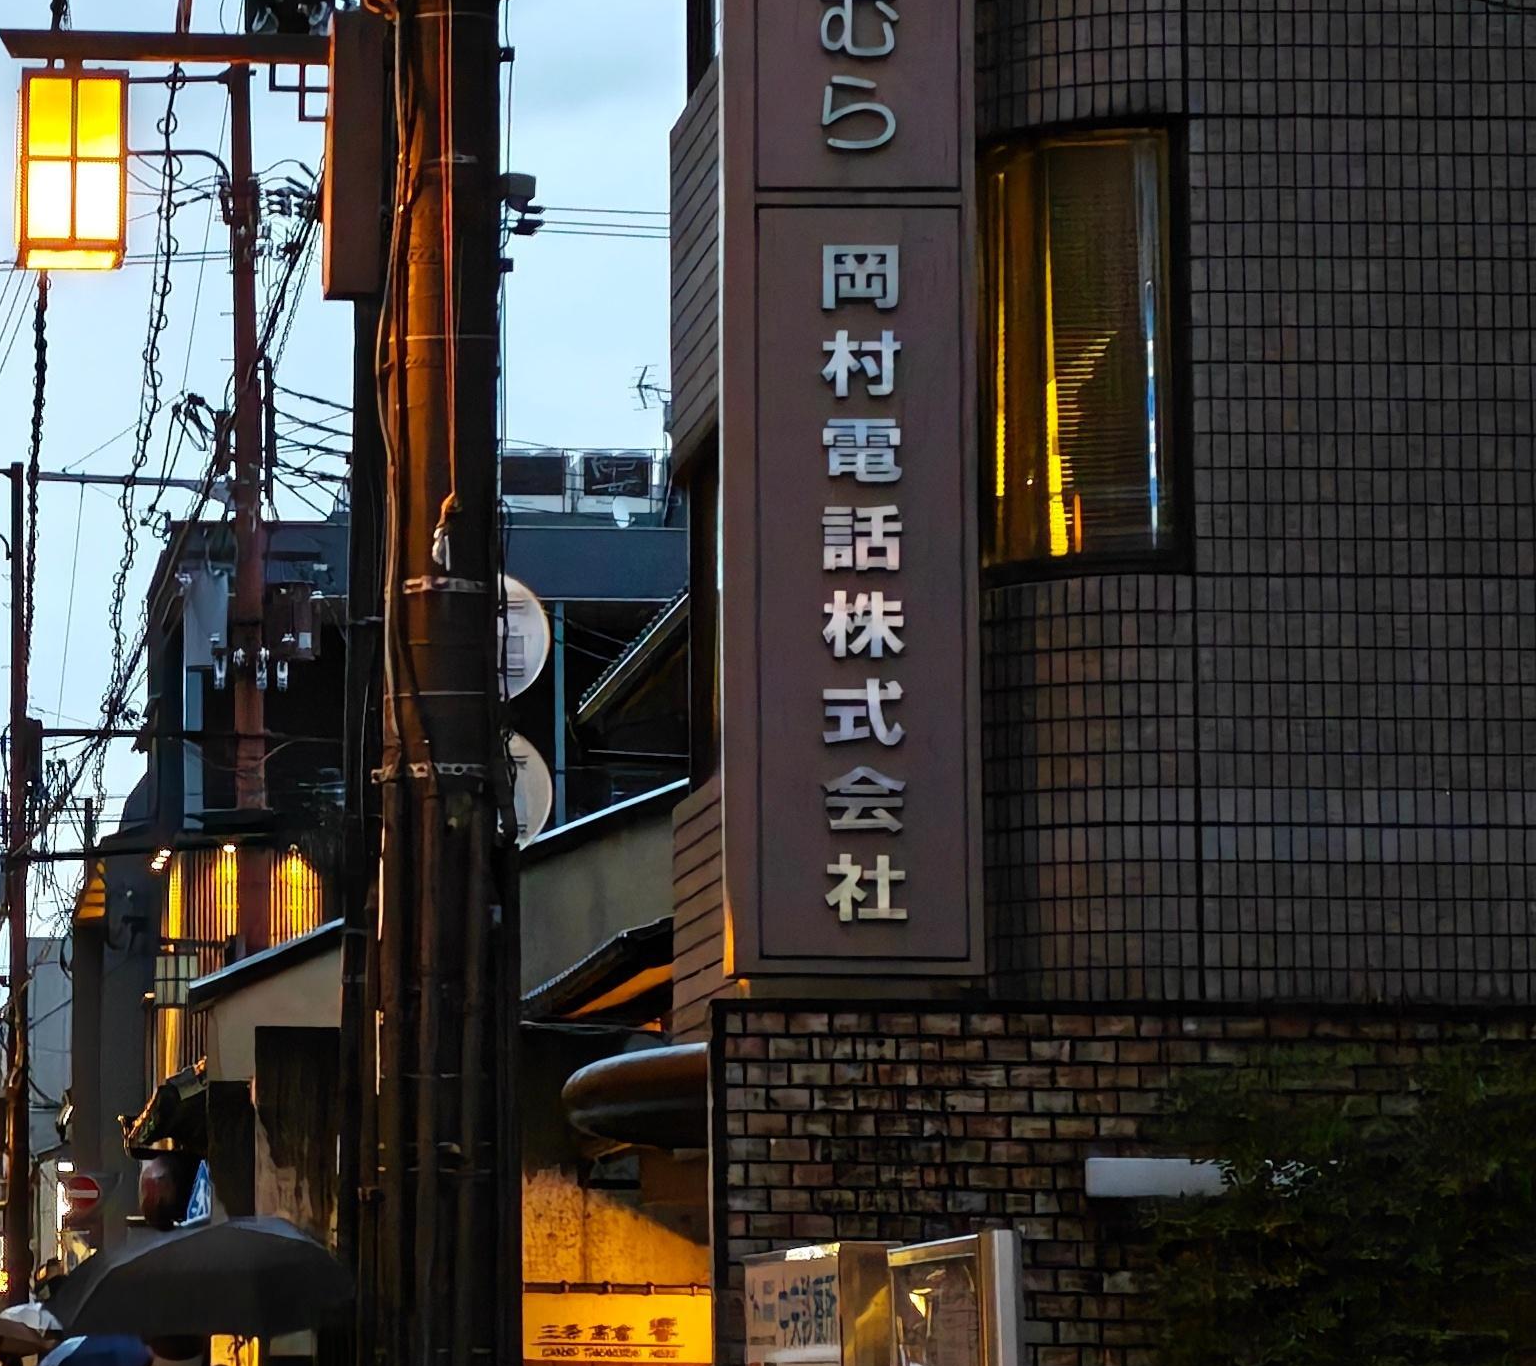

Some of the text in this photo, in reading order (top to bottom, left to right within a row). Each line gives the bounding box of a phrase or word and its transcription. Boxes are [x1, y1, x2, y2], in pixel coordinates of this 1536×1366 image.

[820, 243, 910, 923] 岡村電話株式会社
